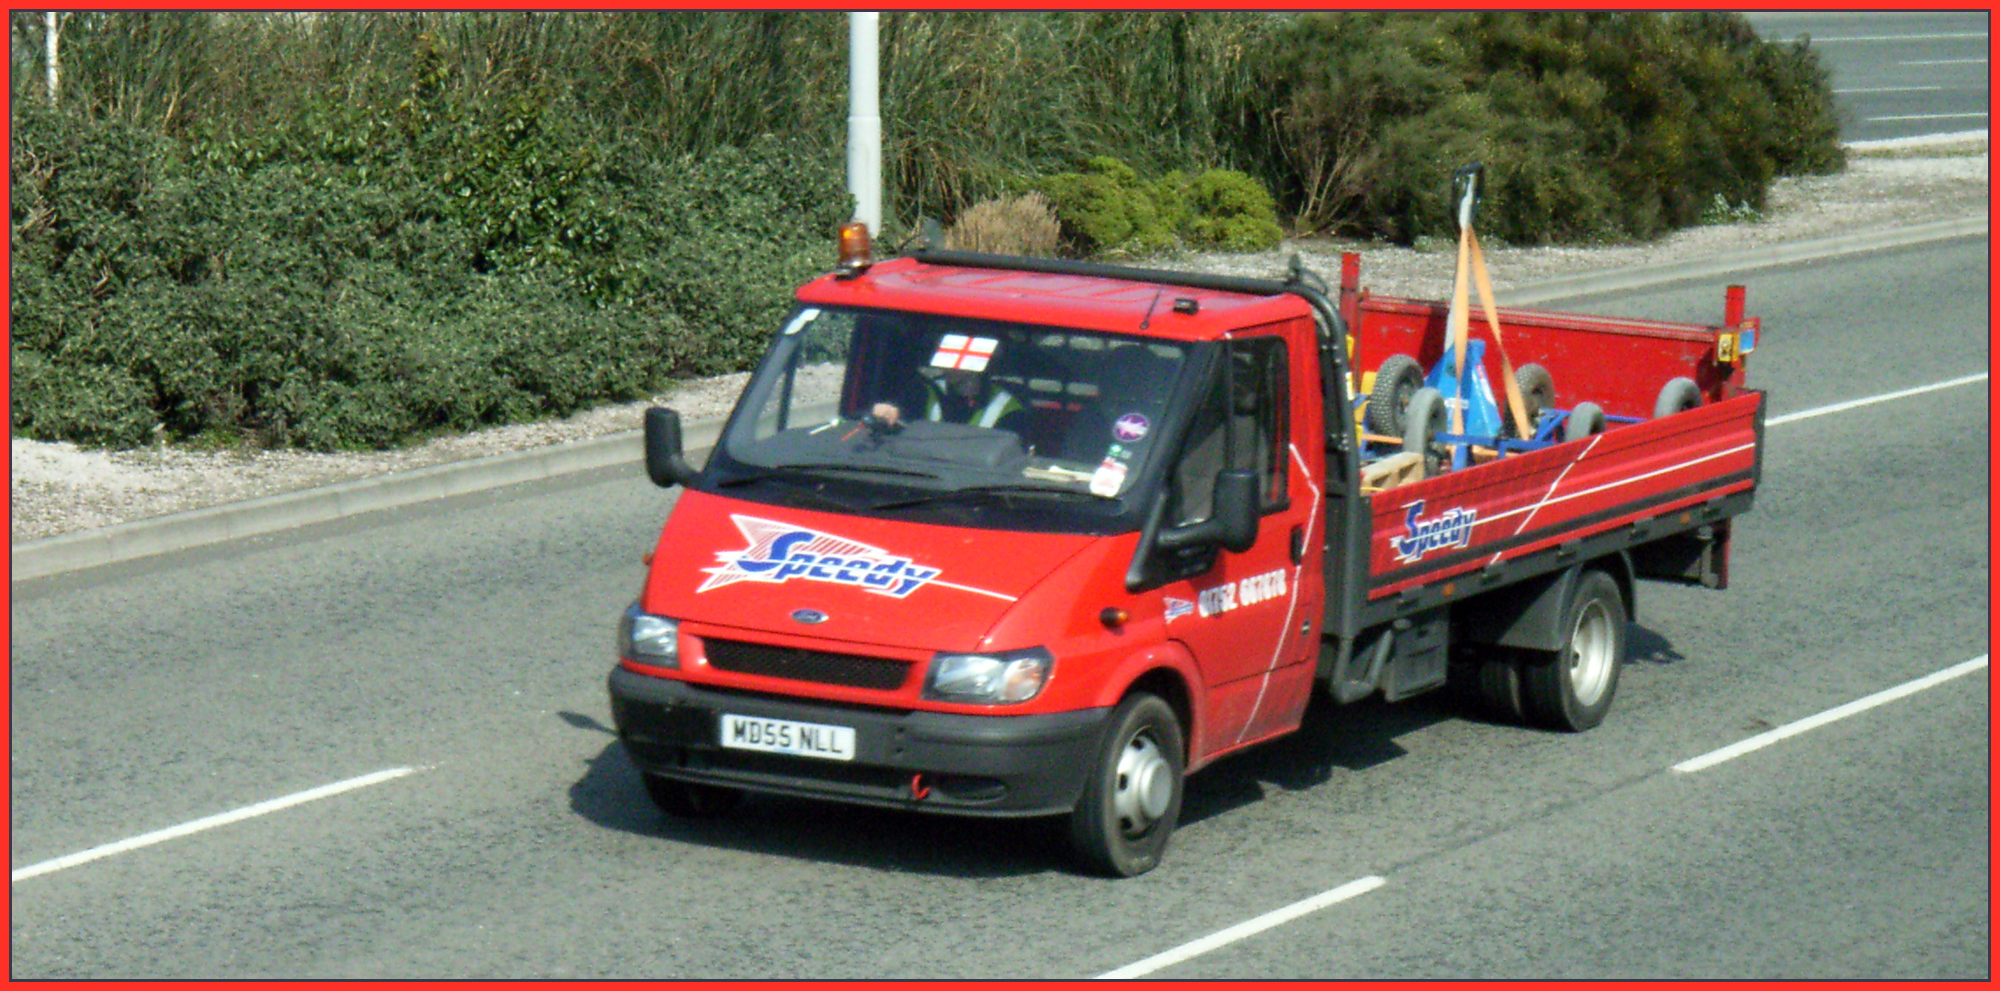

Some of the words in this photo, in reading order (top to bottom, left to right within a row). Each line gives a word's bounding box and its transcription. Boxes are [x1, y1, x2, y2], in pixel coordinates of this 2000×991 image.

[1398, 500, 1476, 559] Speedy
[736, 530, 937, 596] Speedy
[733, 719, 791, 748] MD55
[799, 726, 843, 754] NLL
